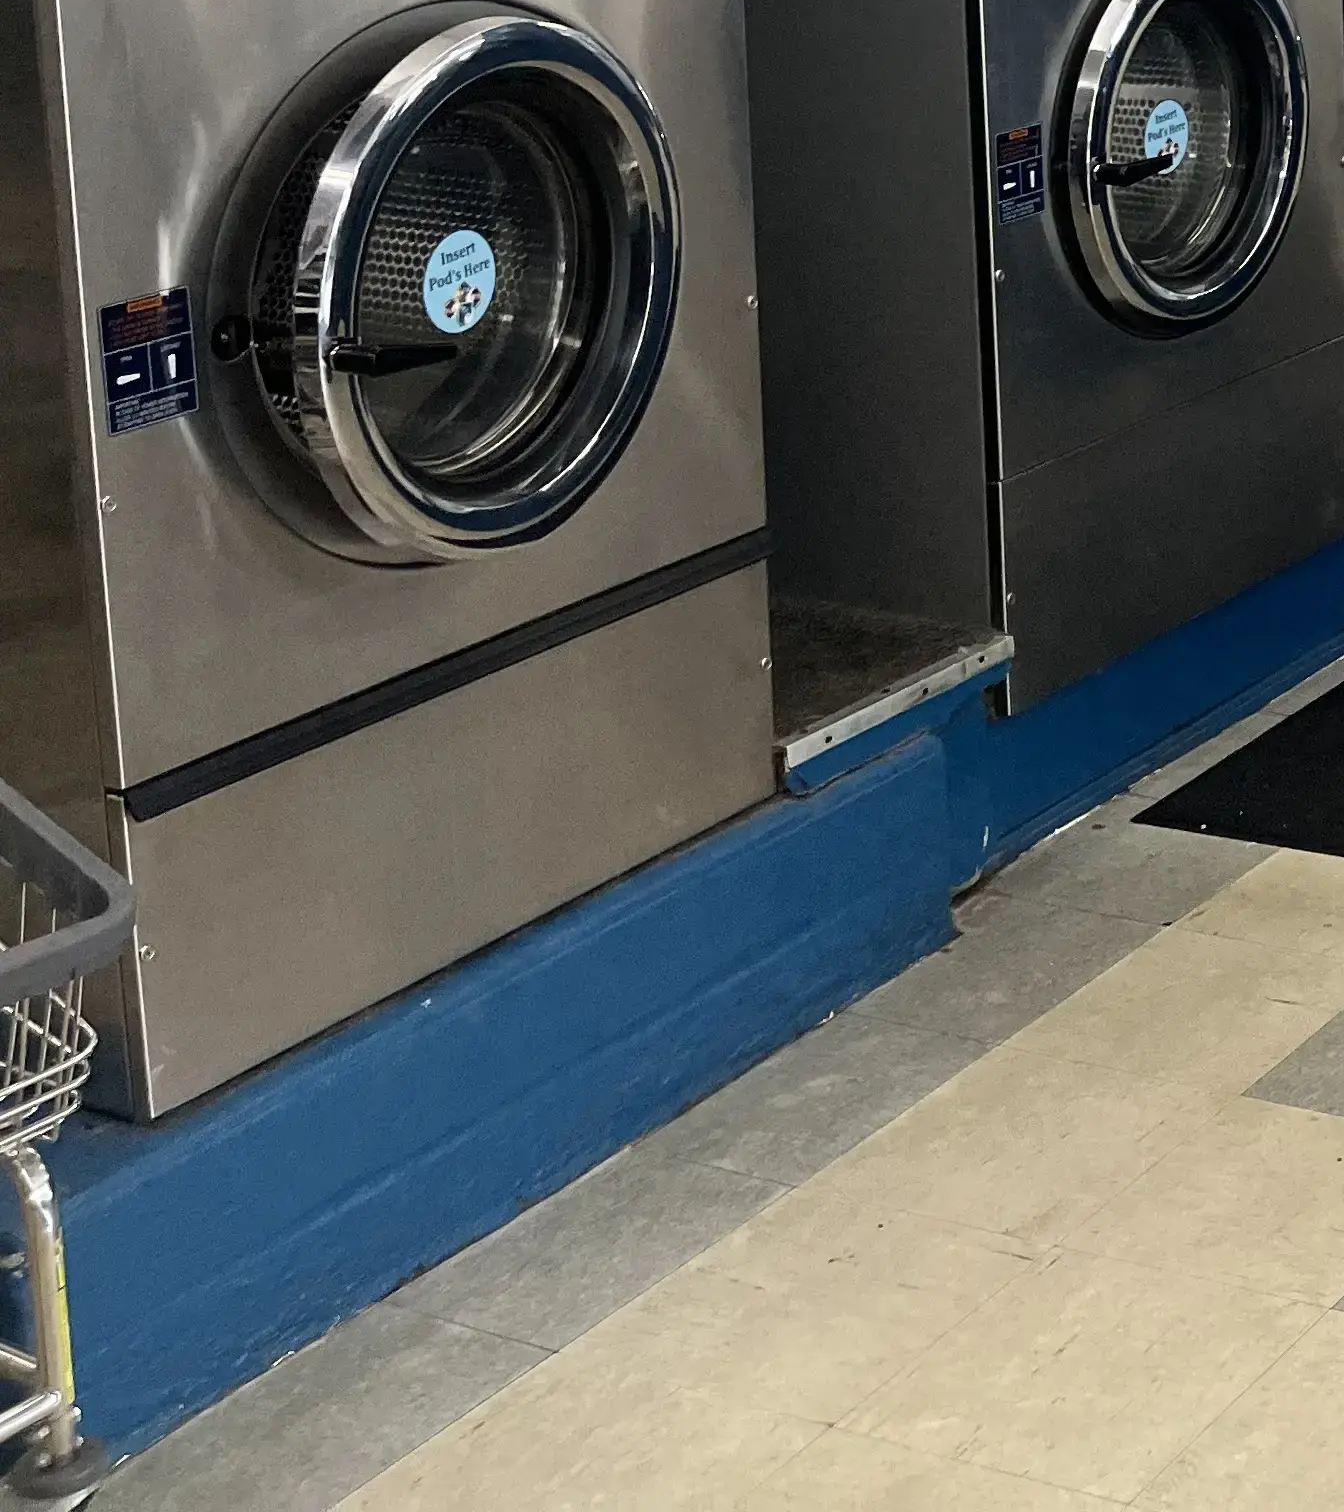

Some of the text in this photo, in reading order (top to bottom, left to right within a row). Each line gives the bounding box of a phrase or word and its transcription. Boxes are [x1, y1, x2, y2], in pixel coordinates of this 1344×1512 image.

[440, 242, 476, 266] Insert
[428, 258, 491, 292] Pod's Here
